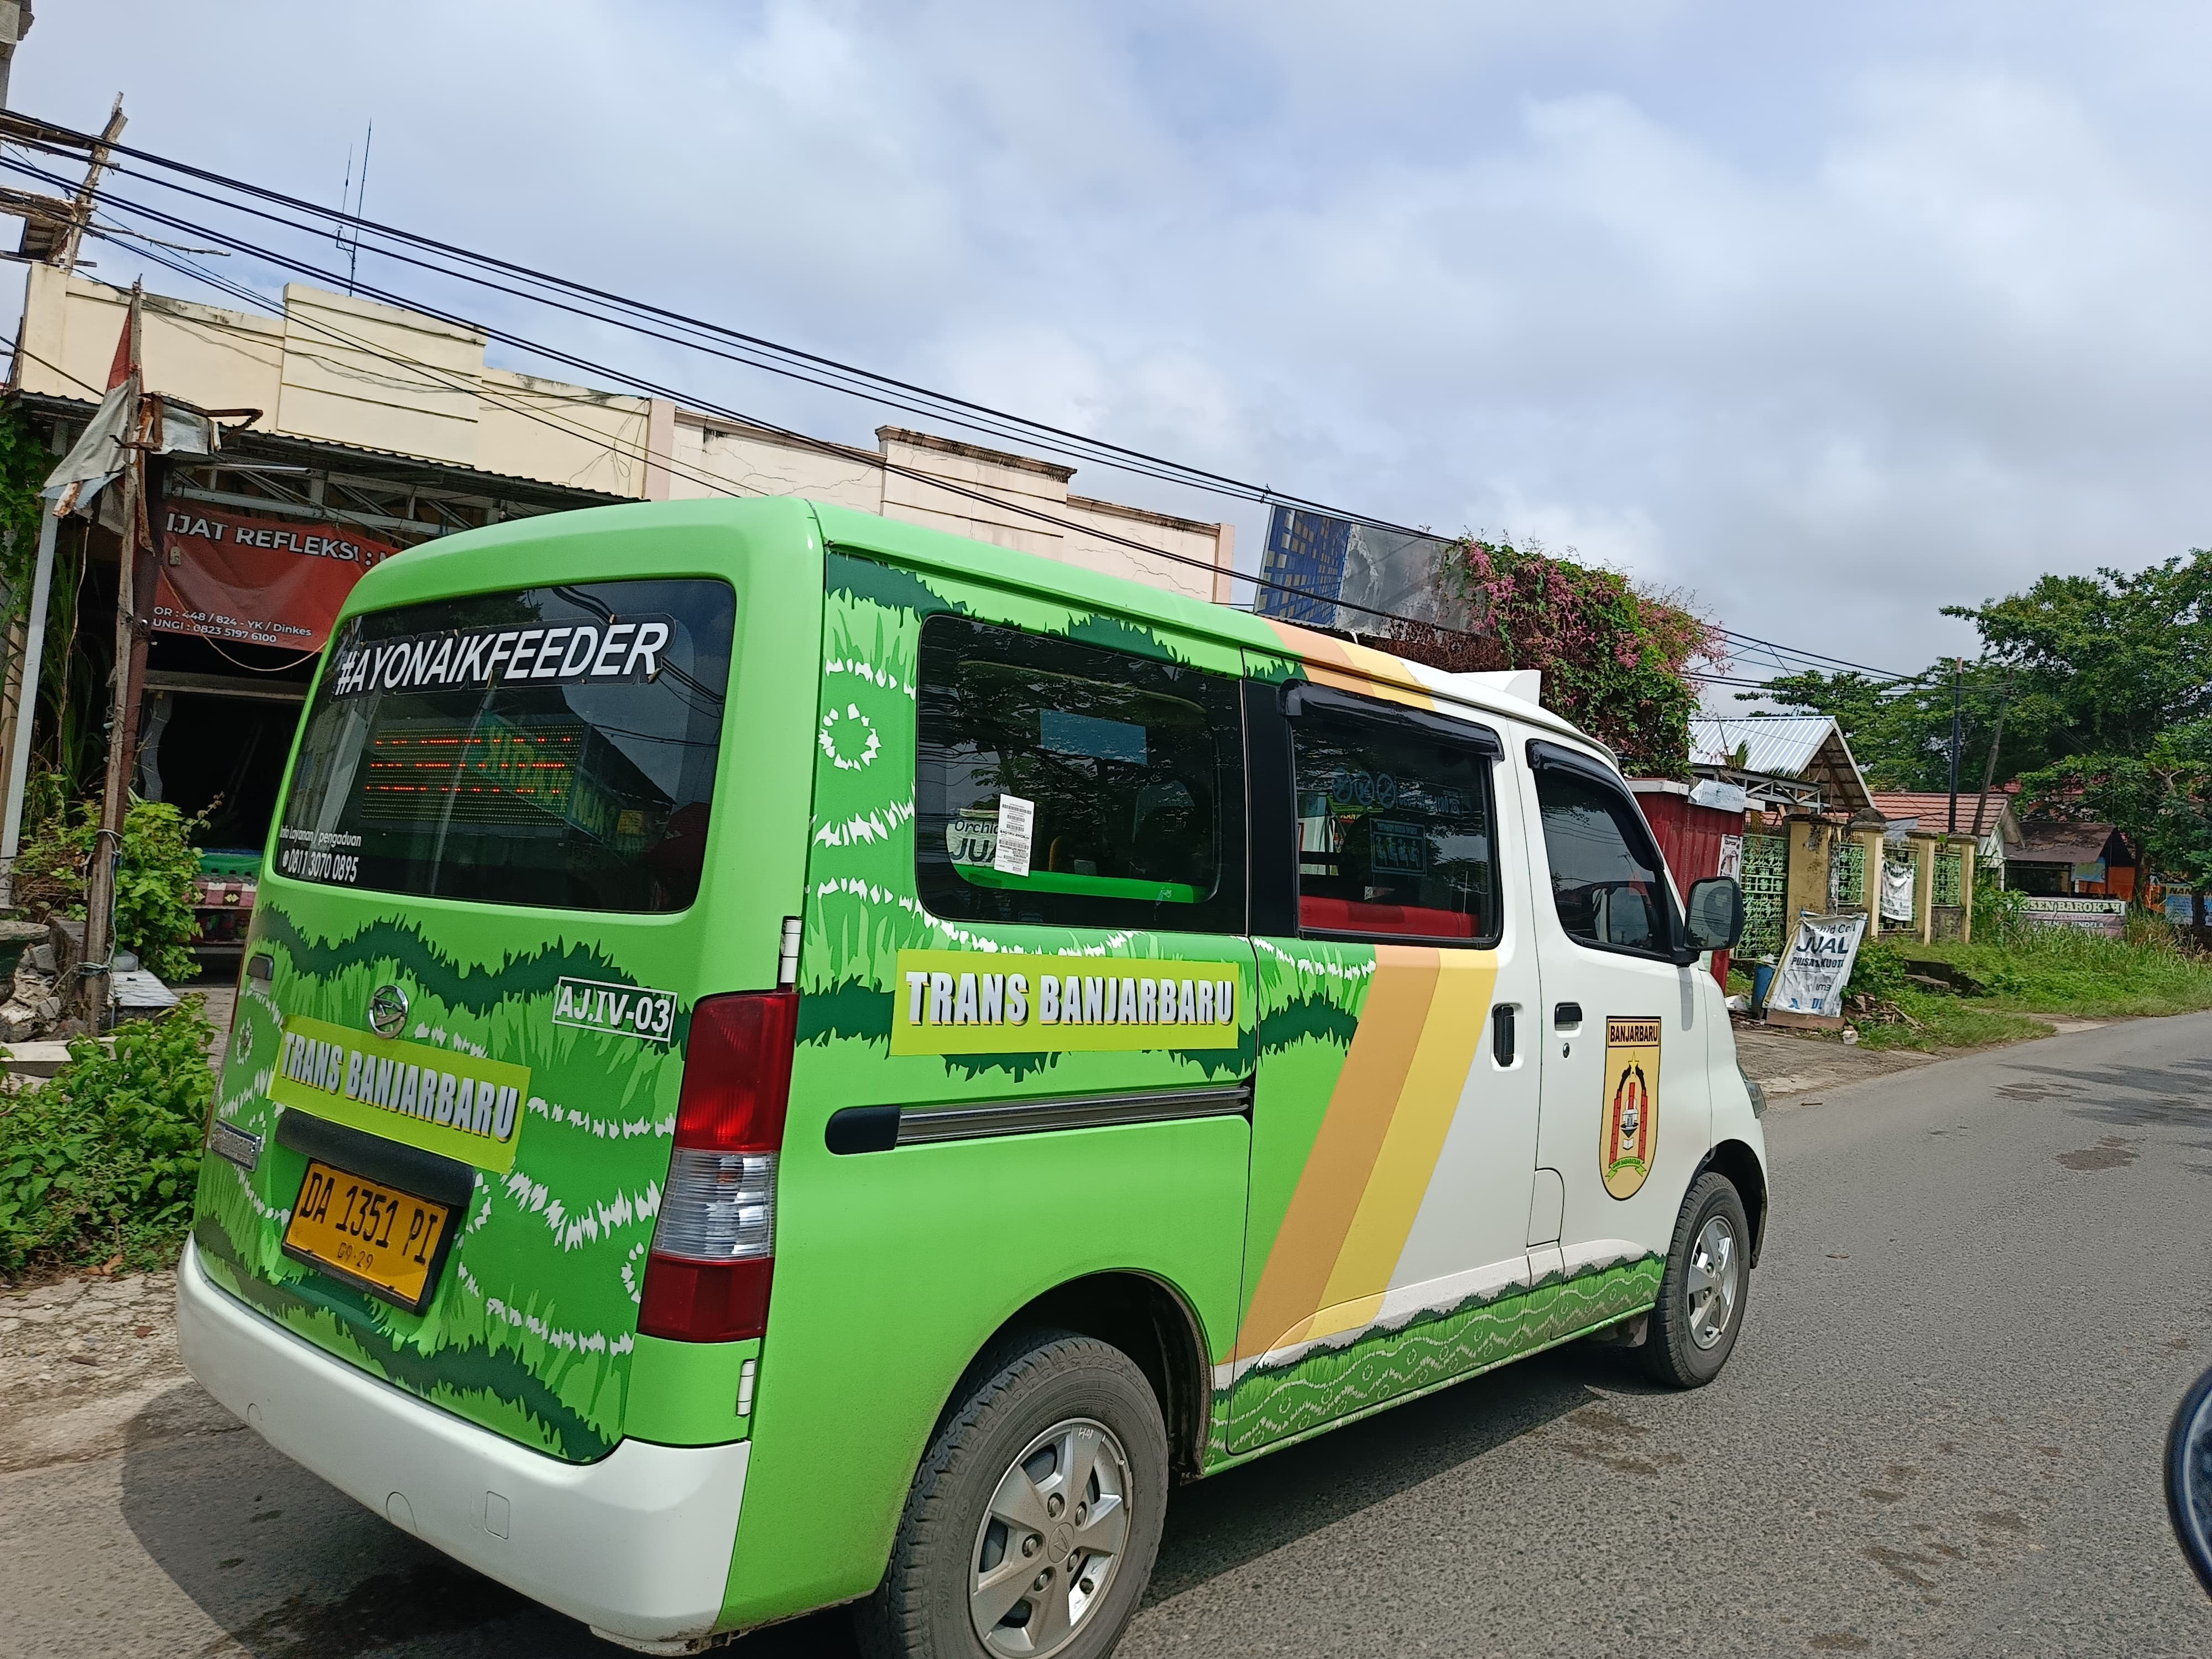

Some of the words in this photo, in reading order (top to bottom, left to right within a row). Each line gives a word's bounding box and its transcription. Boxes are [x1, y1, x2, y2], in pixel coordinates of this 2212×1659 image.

[166, 513, 228, 540] IJAT
[236, 527, 359, 562] REFLEKSI
[153, 618, 184, 629] UNGI
[194, 624, 222, 635] 0823
[223, 629, 249, 639] 5197
[251, 633, 277, 643] 6100
[154, 607, 171, 616] OR
[182, 611, 206, 620] 448
[216, 615, 237, 626] 824
[247, 620, 263, 629] YK
[273, 623, 312, 636] Dinkes
[335, 623, 669, 696] #AYONAIKFEEDER
[318, 831, 361, 848] pengaduan
[288, 848, 309, 874] 0811
[308, 852, 332, 879] 3070
[332, 854, 359, 883] 0895
[2013, 900, 2055, 911] USEN
[2057, 901, 2121, 913] BAROKAH
[1796, 936, 1849, 954] JUAL
[556, 985, 671, 1034] AJ.IV-03
[906, 971, 1029, 1027] TRANS
[1039, 974, 1234, 1027] BANJARBARU
[1610, 1025, 1658, 1043] BANJARBARU
[281, 1031, 343, 1094] TRANS
[345, 1050, 519, 1143] BANJARBARU
[299, 1172, 335, 1224] DA
[336, 1185, 399, 1249] 1351
[403, 1208, 439, 1266] PI
